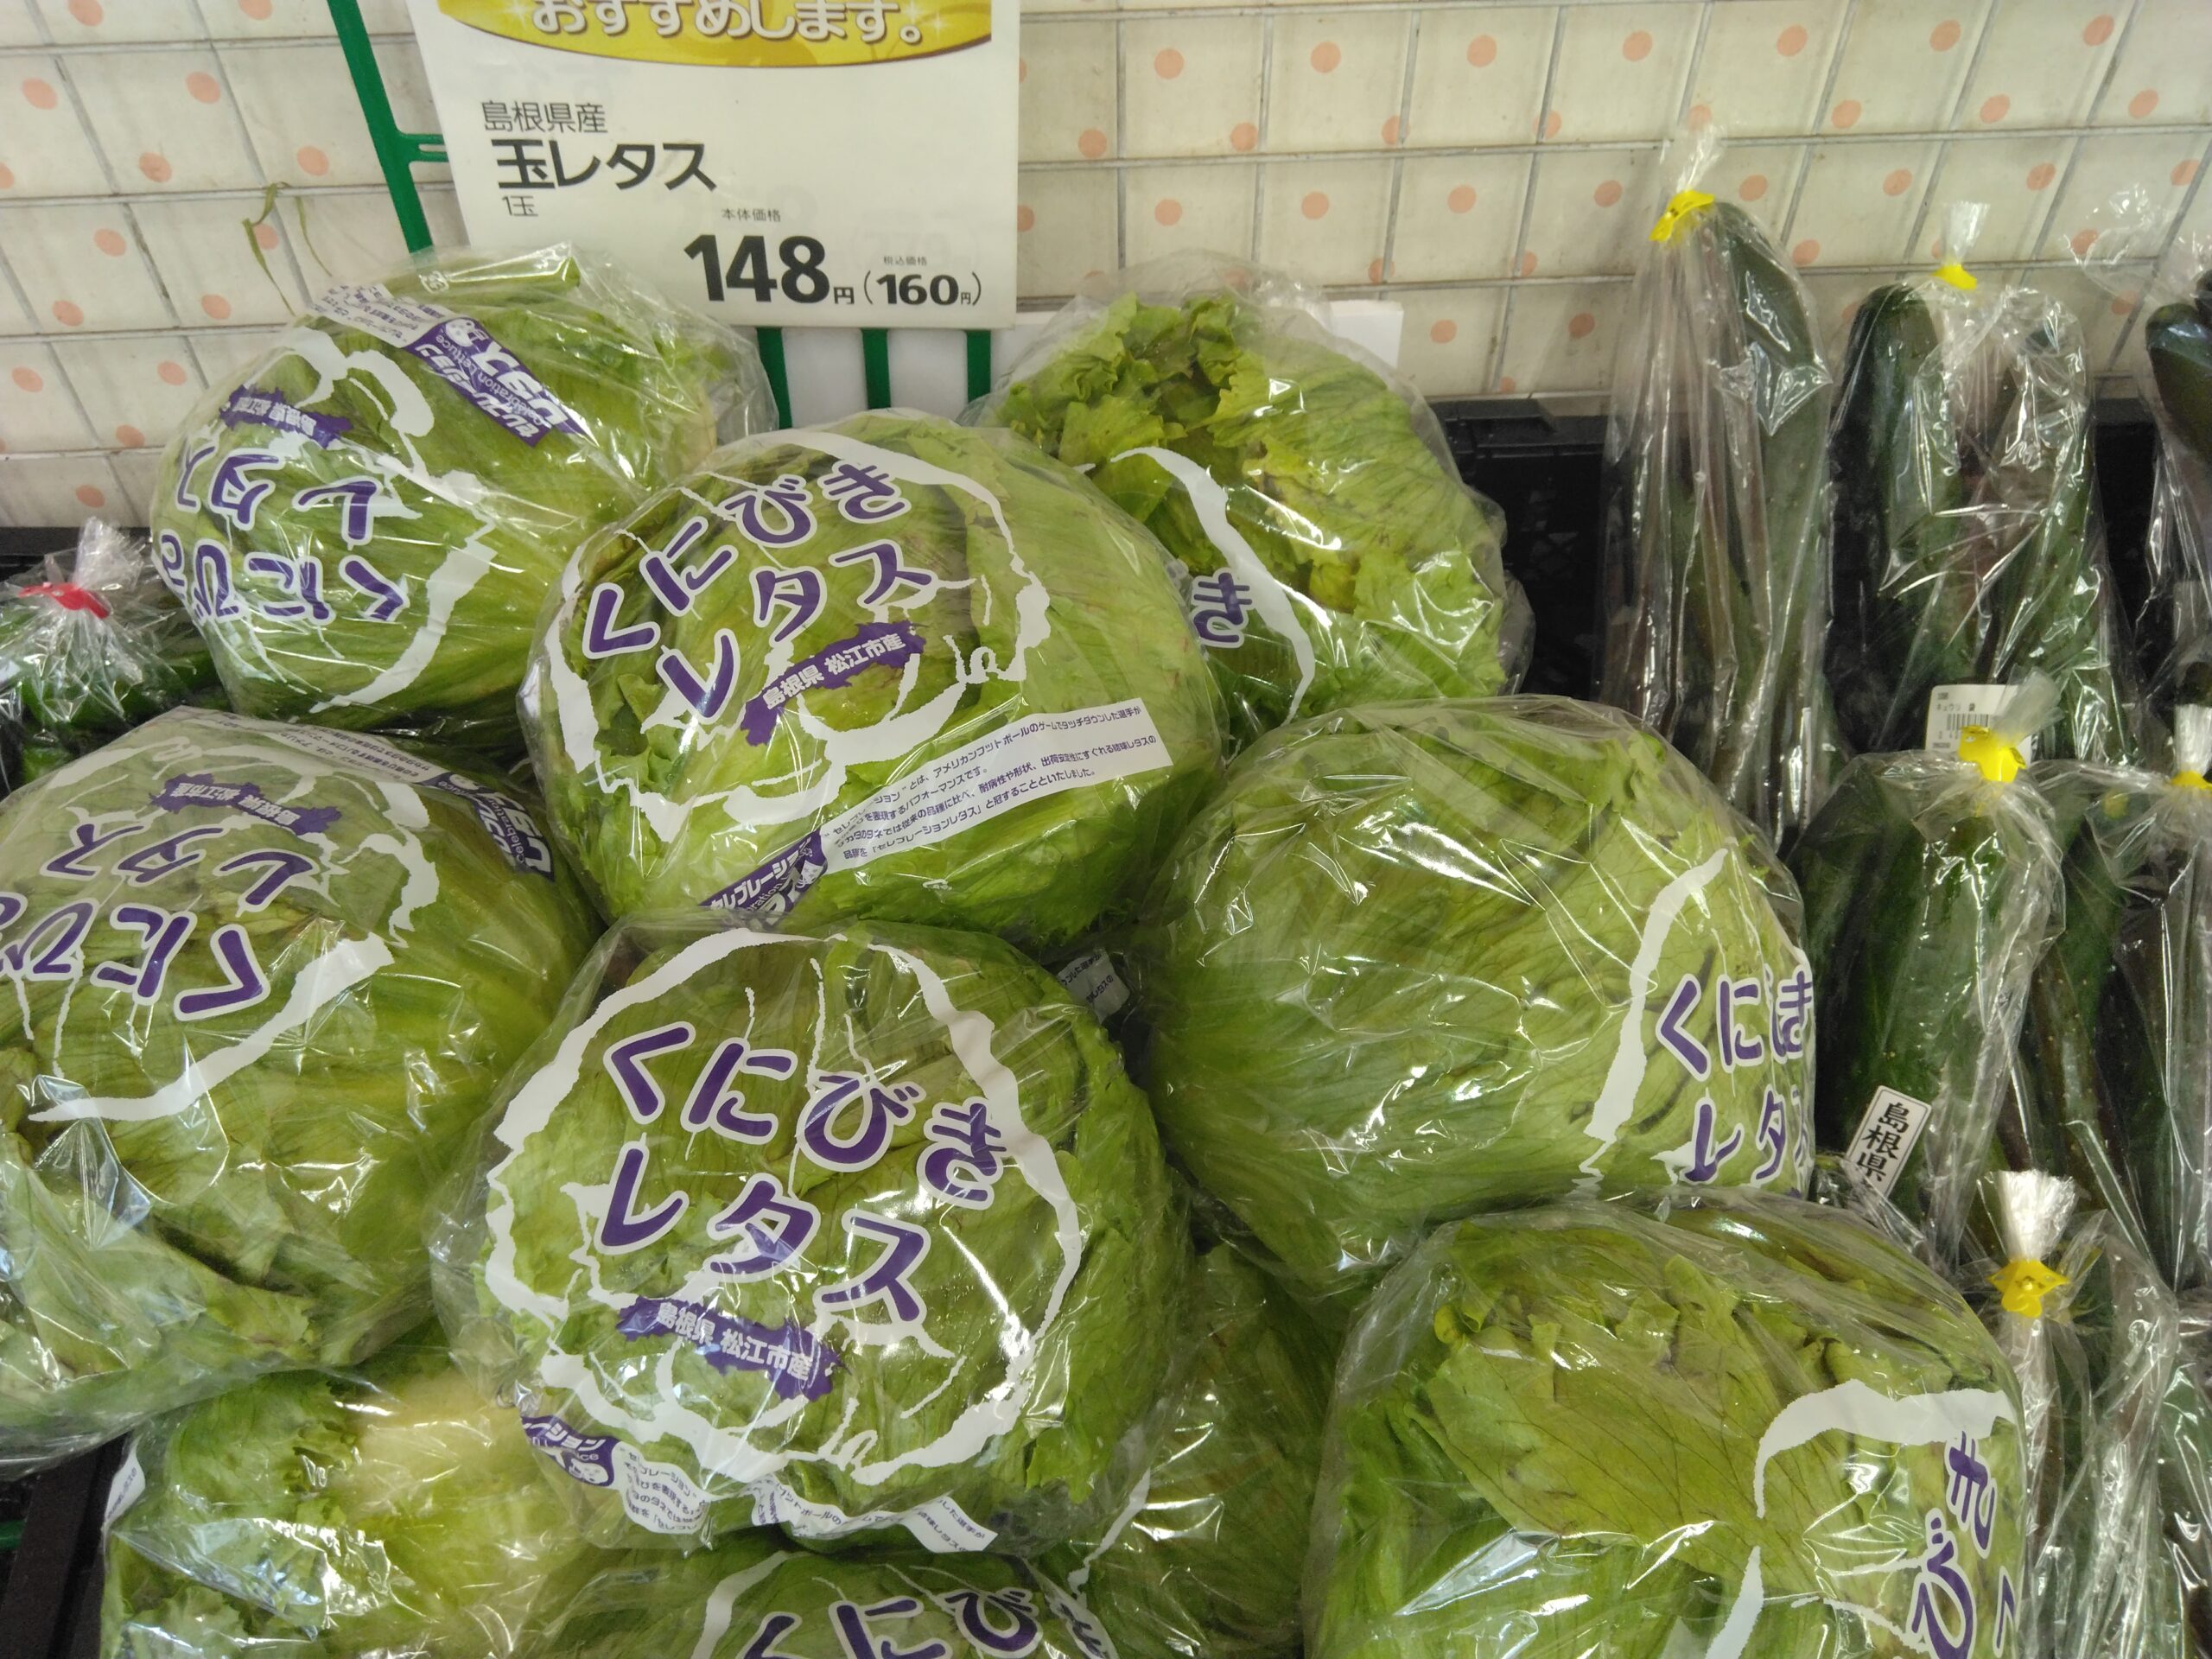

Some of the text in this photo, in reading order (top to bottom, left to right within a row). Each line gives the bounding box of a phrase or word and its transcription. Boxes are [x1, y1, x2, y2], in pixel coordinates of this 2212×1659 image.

[531, 0, 922, 43] おすすめします。
[481, 100, 607, 133] 島根県産
[491, 138, 717, 192] 玉レタス
[502, 195, 538, 217] 1玉
[722, 208, 781, 222] 本体価格
[884, 256, 927, 266] 税込価格
[585, 462, 907, 656] くにびき
[659, 539, 940, 722] レタス
[761, 632, 905, 712] 島根県 松江市産
[43, 823, 314, 911] レタス
[605, 1020, 1011, 1208] くにびき
[1857, 1103, 1910, 1184] 島根県
[599, 1144, 929, 1326] レタス
[656, 1301, 813, 1382] 島根県 松江市産
